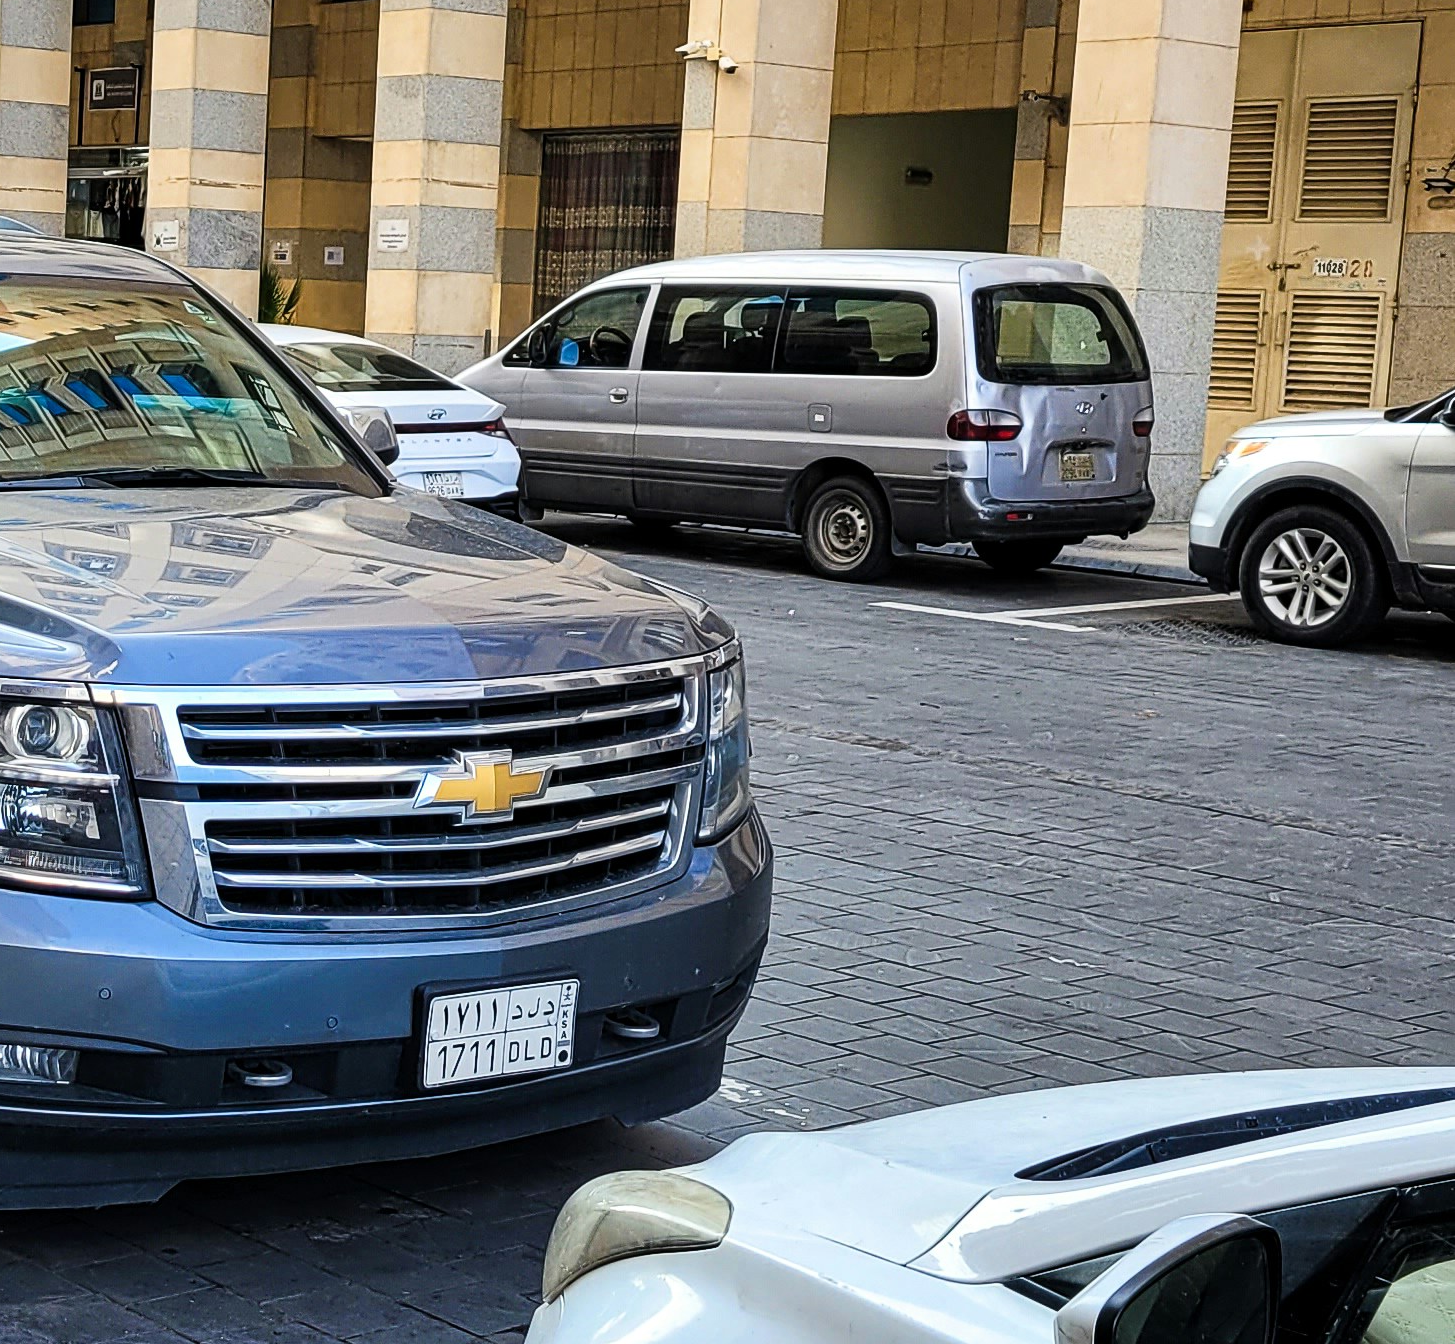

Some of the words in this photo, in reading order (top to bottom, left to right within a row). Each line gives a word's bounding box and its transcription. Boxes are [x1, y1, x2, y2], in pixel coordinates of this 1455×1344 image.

[1317, 261, 1344, 274] 11028
[443, 997, 497, 1036] ١٧١١
[438, 1038, 496, 1079] 1711
[509, 1037, 552, 1063] DLD
